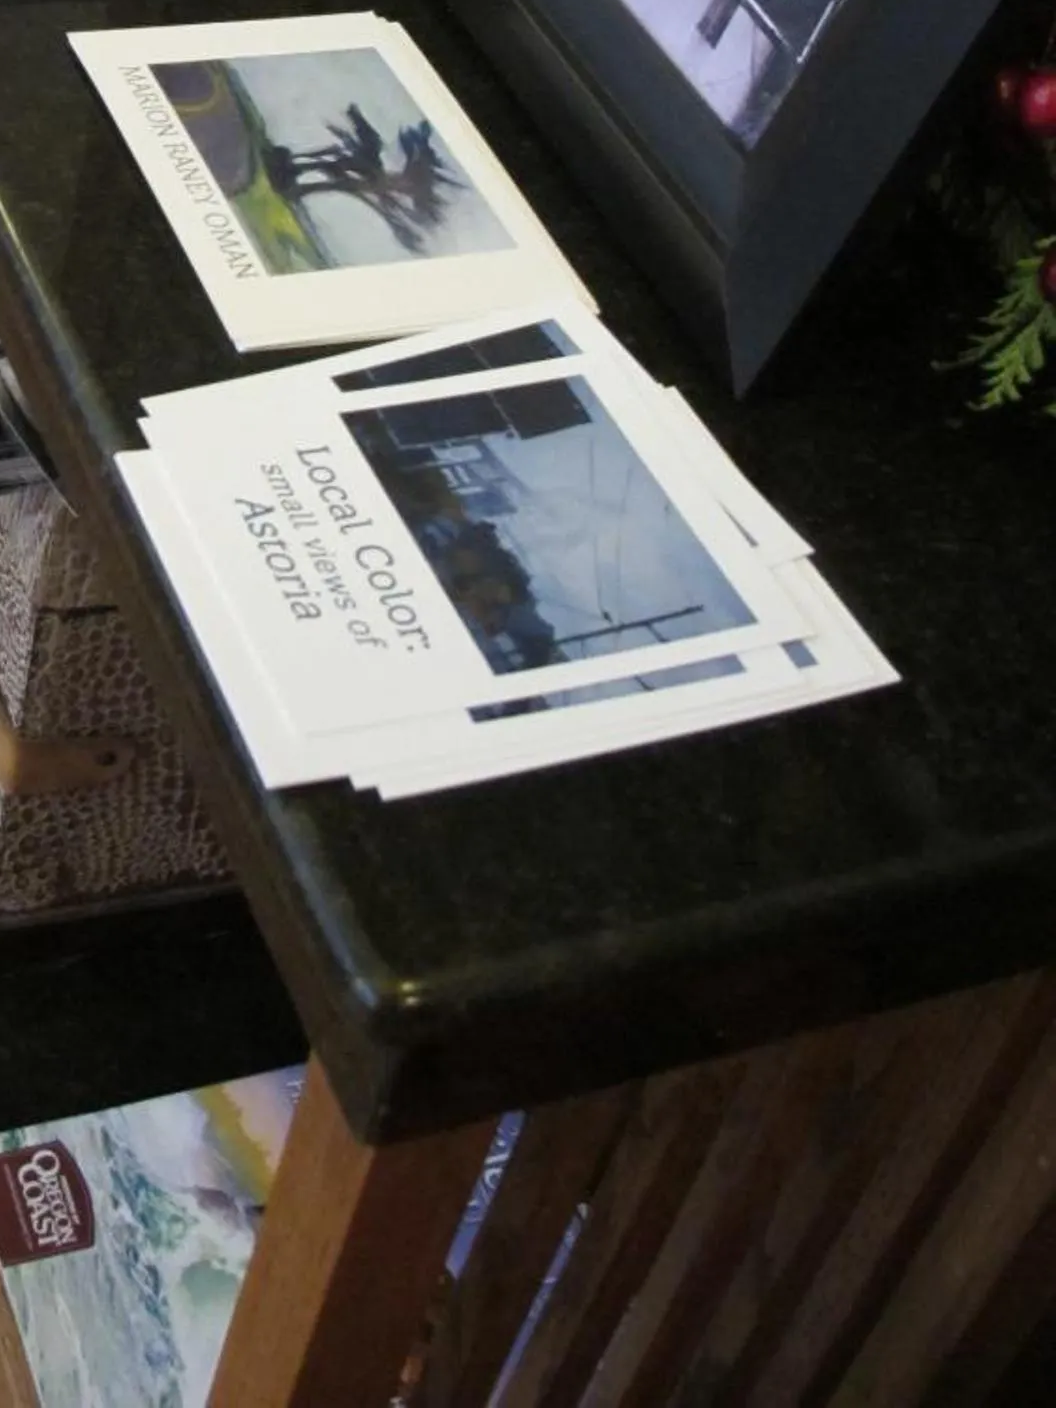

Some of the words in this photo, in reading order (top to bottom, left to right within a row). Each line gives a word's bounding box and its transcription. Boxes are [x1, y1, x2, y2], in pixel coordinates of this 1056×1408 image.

[118, 64, 179, 137] MARION
[162, 140, 221, 204] RANEY
[203, 211, 260, 280] OMAN
[295, 444, 374, 536] Local
[234, 496, 323, 621] Astoria
[259, 462, 319, 530] small
[305, 537, 358, 612] views
[346, 618, 389, 650] of
[17, 1163, 60, 1248] COAST
